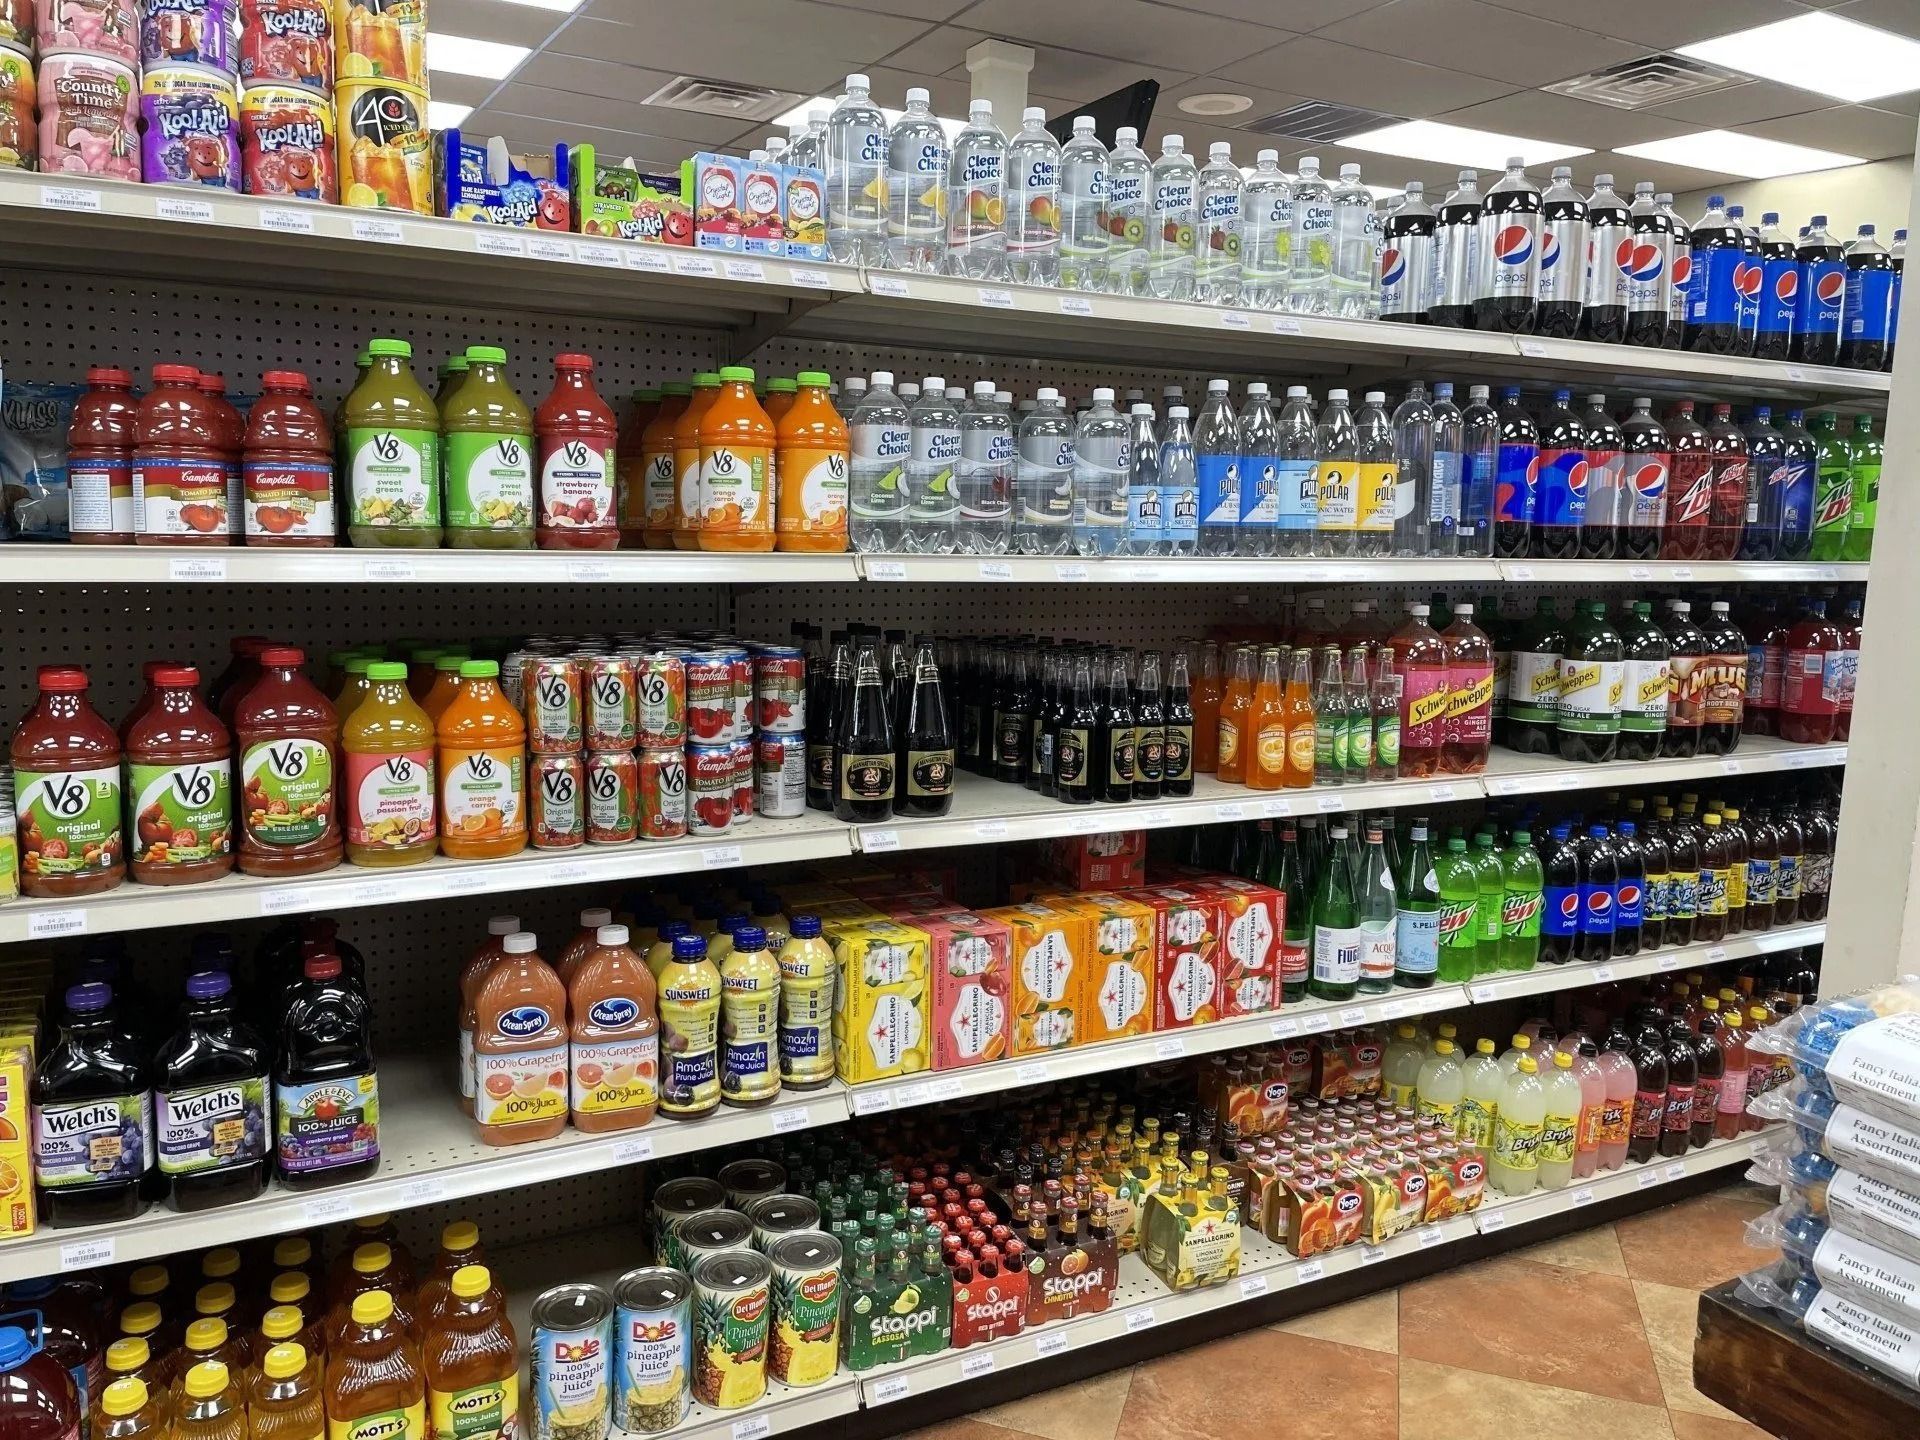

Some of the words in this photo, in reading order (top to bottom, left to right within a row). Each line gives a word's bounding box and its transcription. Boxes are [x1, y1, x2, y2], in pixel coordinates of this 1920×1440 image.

[262, 8, 326, 38] Kool-Aid
[61, 80, 123, 102] Country
[72, 91, 113, 109] Time
[159, 103, 229, 137] Kool-Aid
[255, 121, 324, 151] Kool-Aid
[968, 155, 1001, 168] Clear
[963, 166, 1003, 181] Choice
[705, 182, 730, 197] Crystal
[713, 191, 733, 203] Light
[749, 190, 773, 203] Crystal
[1158, 185, 1191, 198] Clear
[791, 193, 813, 208] Crystal
[1154, 197, 1192, 211] Choice
[1206, 195, 1238, 208] Clear
[487, 199, 538, 224] Kool-Aid
[1202, 206, 1239, 219] Choice
[618, 213, 664, 238] Kool-Aid
[1495, 272, 1529, 286] pepsi
[881, 431, 910, 443] Clear
[932, 435, 961, 447] Clear
[373, 432, 400, 459] V8
[498, 437, 519, 465] V8
[564, 439, 586, 464] V8
[877, 443, 911, 456] Choice
[928, 446, 961, 459] Choice
[713, 448, 733, 472] V8
[828, 453, 844, 476] V8
[181, 470, 219, 484] Campbell's
[256, 472, 296, 485] Campbell's
[375, 486, 404, 494] greens
[556, 481, 598, 491] strawberry
[181, 490, 206, 498] TOMATO
[255, 491, 279, 499] TOMATO
[281, 489, 299, 497] JUICE
[1320, 487, 1349, 501] POLAR
[539, 674, 567, 707] V8
[593, 672, 622, 705] V8
[639, 672, 665, 704] V8
[1722, 700, 1739, 708] BEER
[594, 710, 623, 720] Original
[270, 742, 302, 777] V8
[467, 752, 491, 777] V8
[386, 755, 410, 781] V8
[174, 766, 211, 805] V8
[281, 780, 320, 793] original
[543, 769, 572, 802] V8
[590, 767, 617, 799] V8
[660, 762, 685, 797] V8
[695, 777, 721, 788] TOMATO
[44, 775, 84, 814] V8
[468, 795, 497, 803] orange
[380, 797, 418, 808] pineapple
[591, 803, 617, 812] Original
[187, 811, 223, 823] original
[545, 807, 574, 817] Original
[57, 820, 101, 834] original
[1699, 880, 1725, 901] Brisk
[1589, 917, 1610, 926] pepsi
[1619, 911, 1639, 920] pepsi
[1249, 907, 1257, 967] SANPELLEGRINO
[665, 988, 711, 1001] SUNSWEET
[1117, 965, 1125, 1028] SANPELLEGRINO
[593, 1010, 614, 1021] Ocean
[613, 1005, 637, 1024] Spray
[502, 1018, 522, 1030] Ocean
[523, 1015, 548, 1032] Spray
[797, 1043, 816, 1054] Juice
[1359, 1049, 1379, 1061] Yoga
[727, 1060, 746, 1071] Prune
[747, 1058, 767, 1070] Juice
[1288, 1051, 1309, 1064] Yoga
[675, 1071, 697, 1082] Prune
[698, 1069, 715, 1081] Juice
[1267, 1084, 1287, 1100] Yoga
[1849, 1070, 1918, 1103] Assortment
[172, 1091, 240, 1119] Welch's
[304, 1089, 330, 1106] APPLE
[330, 1089, 338, 1097] &
[338, 1090, 354, 1102] EVE
[46, 1106, 117, 1133] Welch's
[298, 1120, 327, 1132] 100%
[329, 1115, 358, 1127] JUICE
[166, 1127, 195, 1138] 100%
[306, 1135, 332, 1146] cranberry
[333, 1134, 348, 1143] grape
[1544, 1125, 1576, 1142] Brisk
[40, 1141, 70, 1151] 100%
[1461, 1167, 1480, 1180] Yoga
[1406, 1180, 1425, 1194] Yoga
[1339, 1195, 1360, 1211] Yoga
[1185, 1232, 1235, 1247] SANPELLEGRINO
[1195, 1248, 1224, 1258] LIMONATA
[1838, 1252, 1868, 1274] Fancy
[1871, 1264, 1916, 1292] Italian
[803, 1284, 815, 1295] Del
[815, 1278, 837, 1293] Monte
[1836, 1267, 1906, 1303] Assortment
[736, 1304, 750, 1315] Del
[749, 1295, 768, 1311] Monte
[800, 1299, 841, 1323] Pineapple
[809, 1313, 831, 1331] Juice
[978, 1322, 989, 1331] RED
[1835, 1300, 1866, 1322] Fancy
[1867, 1312, 1912, 1342] Italian
[633, 1320, 677, 1343] Dole
[871, 1332, 905, 1346] GASSOSA
[555, 1338, 600, 1363] Dole
[642, 1342, 667, 1352] 100%
[741, 1336, 761, 1352] Juice
[627, 1342, 681, 1363] pineapple
[549, 1361, 604, 1384] pineapple
[566, 1361, 592, 1372] 100%
[639, 1358, 669, 1374] juice
[563, 1378, 593, 1394] juice
[454, 1391, 502, 1412] MOTT'S
[455, 1415, 474, 1427] 100%
[475, 1411, 500, 1423] Juice
[470, 1425, 488, 1434] APPLE
